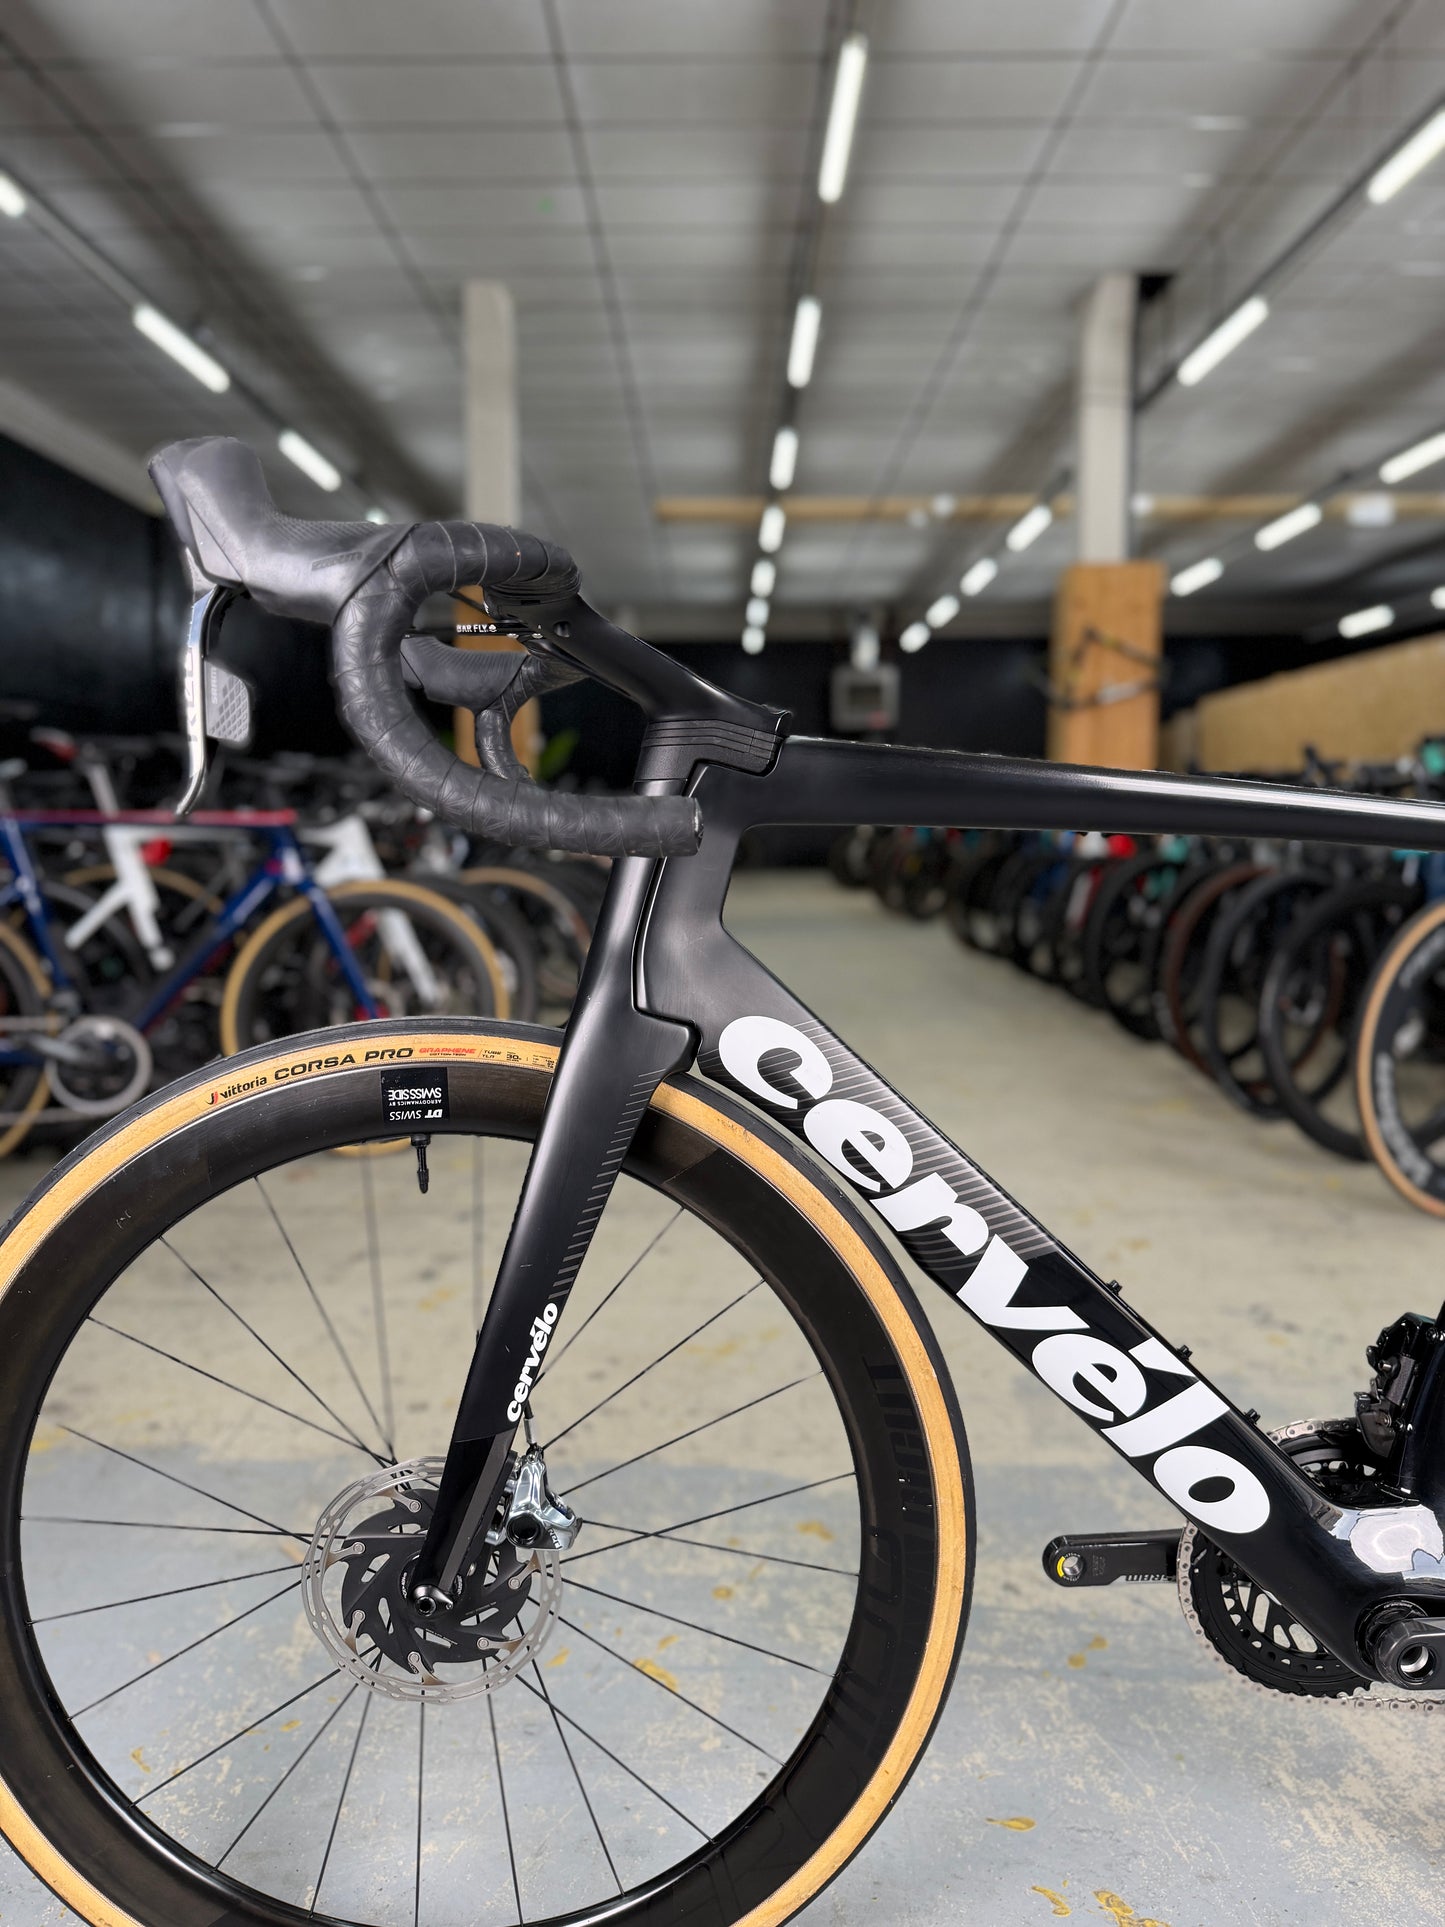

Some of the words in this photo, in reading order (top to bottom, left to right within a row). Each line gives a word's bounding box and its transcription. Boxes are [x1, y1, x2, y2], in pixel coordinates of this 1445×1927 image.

[456, 624, 472, 633] BAR
[473, 624, 487, 633] FLY
[219, 1075, 268, 1099] vittoria
[274, 1053, 356, 1081] CORSA
[364, 1047, 414, 1062] PRO
[389, 1109, 422, 1121] SWISS
[424, 1108, 443, 1119] DT
[719, 1016, 1269, 1533] cervélo
[506, 1302, 558, 1422] cervélo
